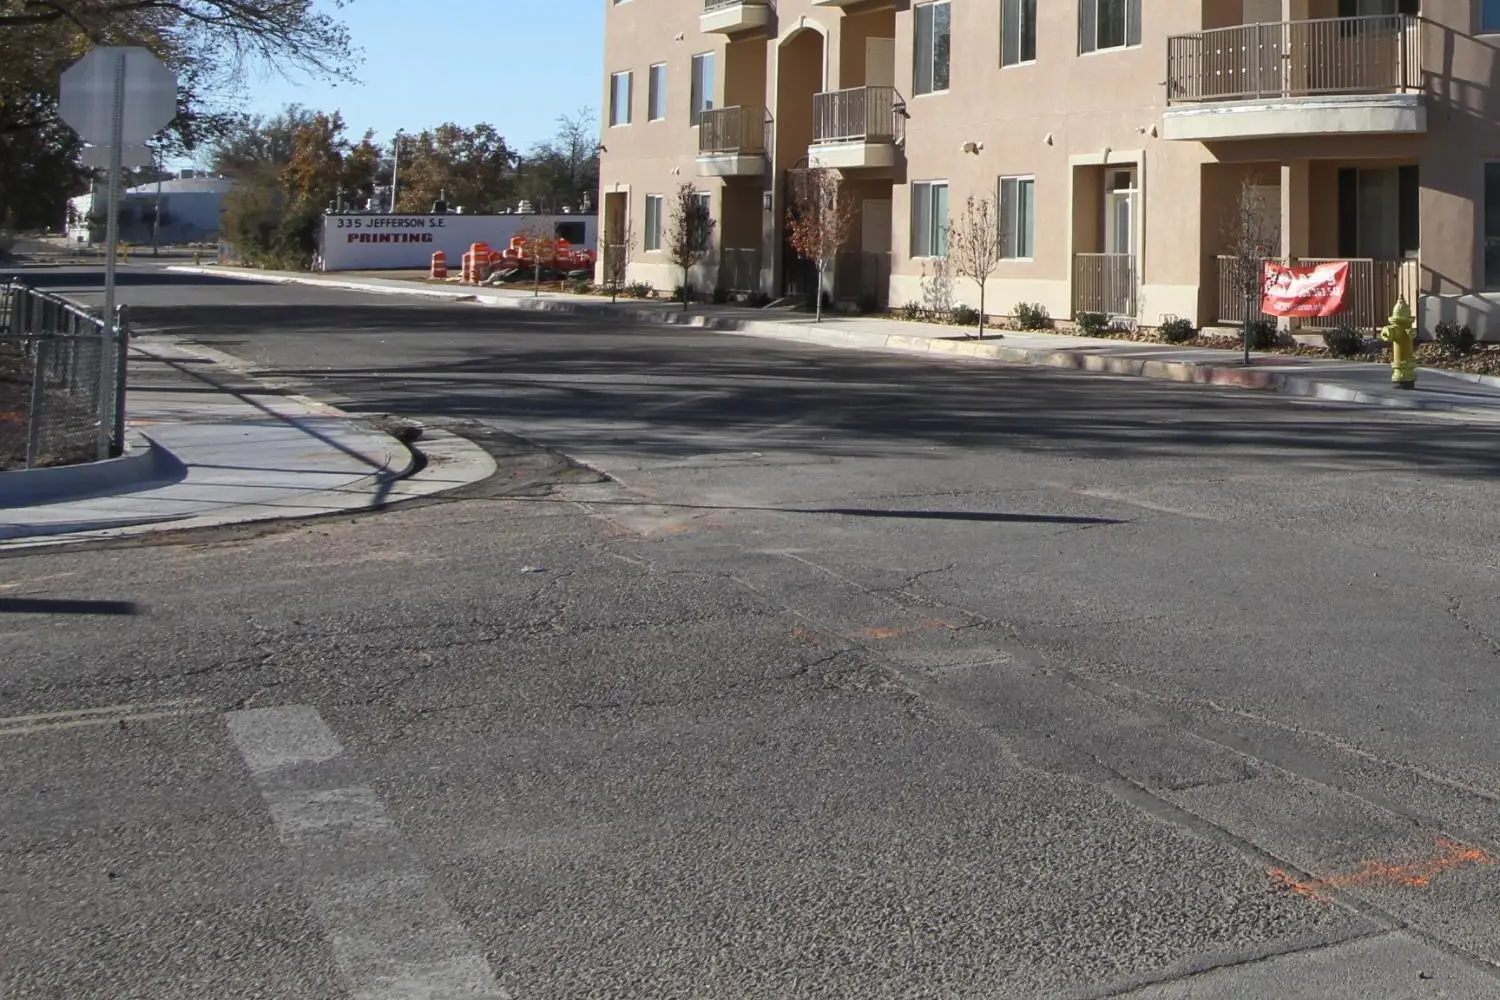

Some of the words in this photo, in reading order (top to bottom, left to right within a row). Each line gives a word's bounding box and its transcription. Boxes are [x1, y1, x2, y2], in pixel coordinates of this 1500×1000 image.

[337, 218, 362, 228] 335
[366, 218, 425, 228] JEFFERSON
[347, 232, 433, 243] PRINTING
